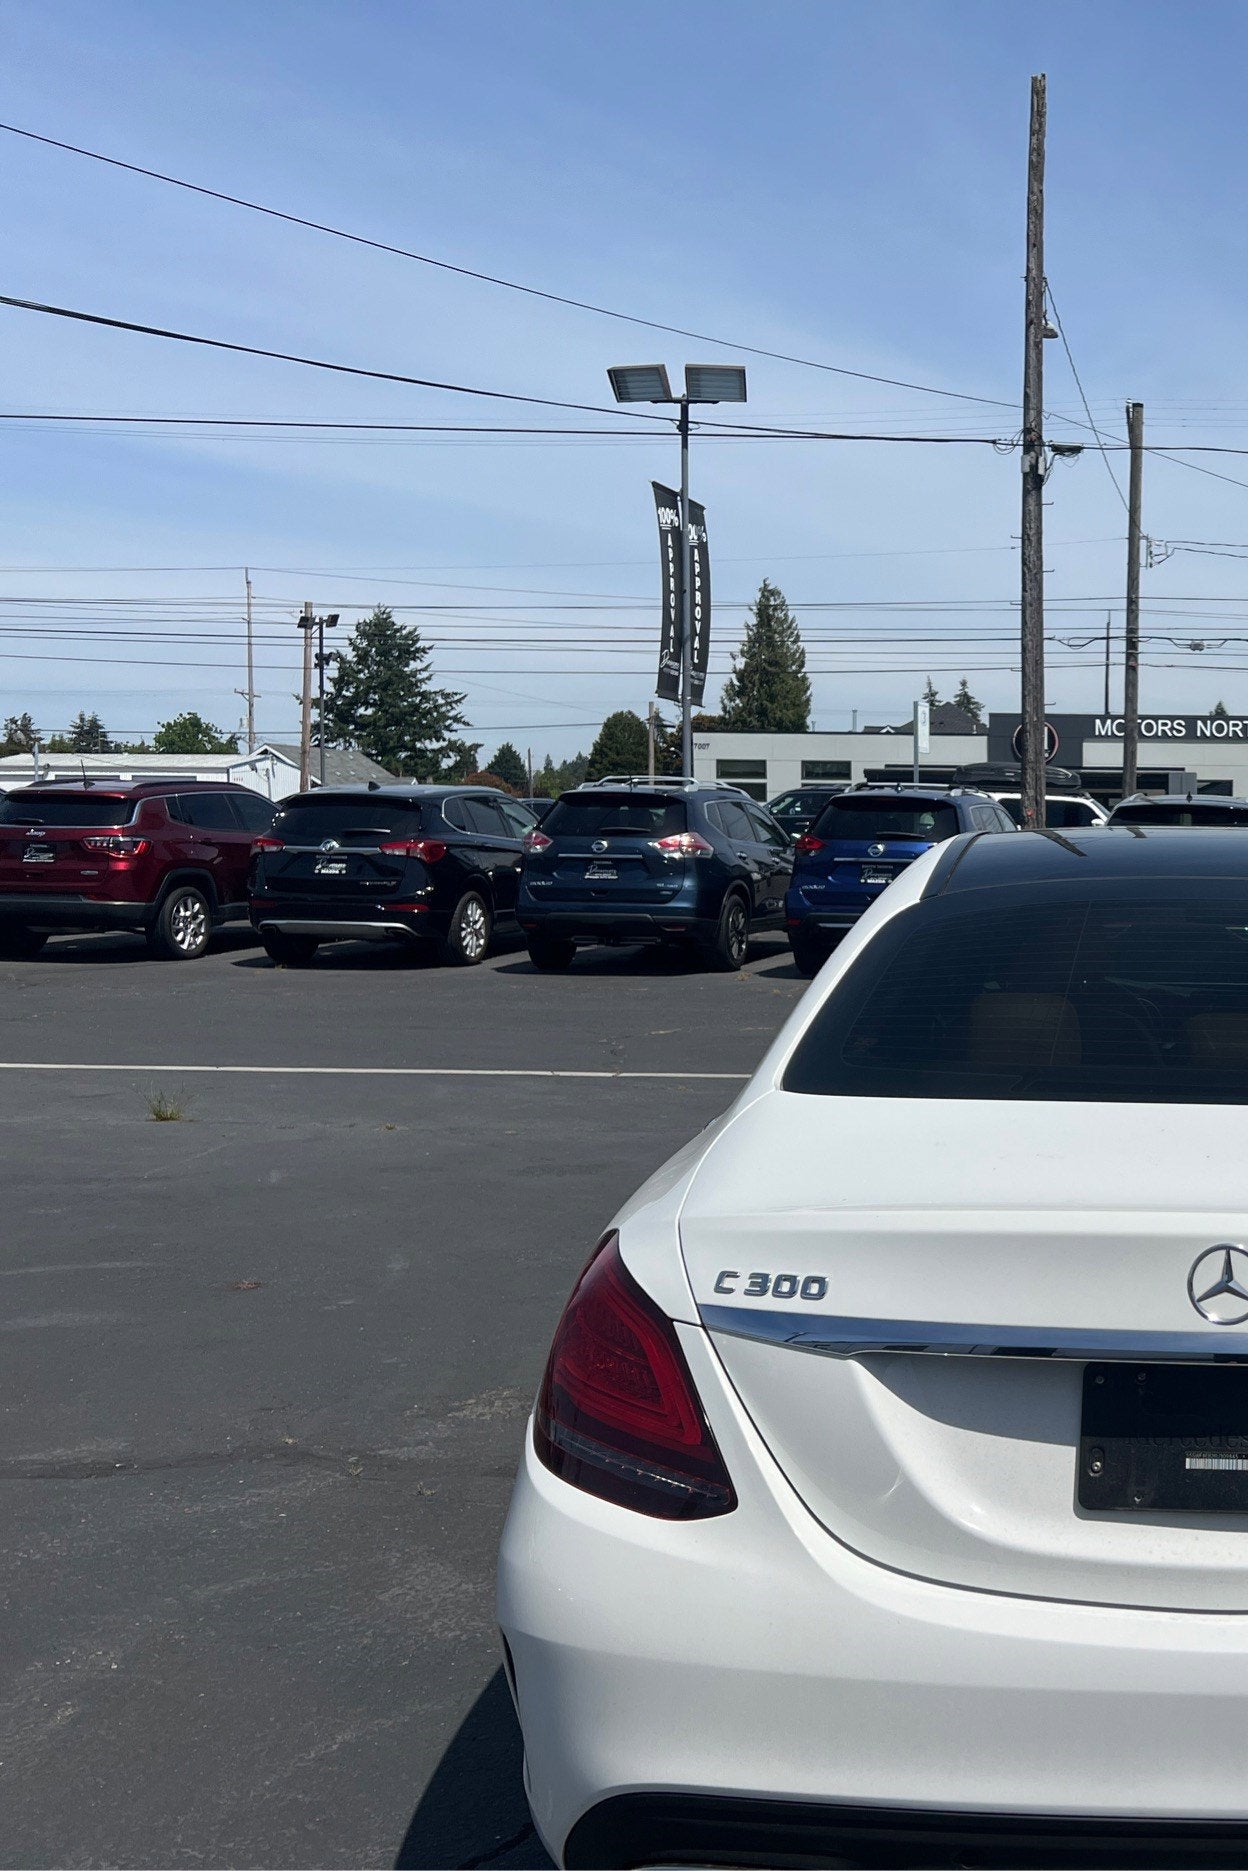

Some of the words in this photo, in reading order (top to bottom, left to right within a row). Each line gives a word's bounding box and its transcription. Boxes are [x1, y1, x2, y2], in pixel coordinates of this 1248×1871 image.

[658, 507, 679, 527] 100%
[667, 533, 675, 653] APPROVAL
[693, 548, 702, 663] APPROVAL
[1094, 719, 1186, 736] MOORS
[714, 1270, 741, 1294] C
[743, 1272, 829, 1301] 300
